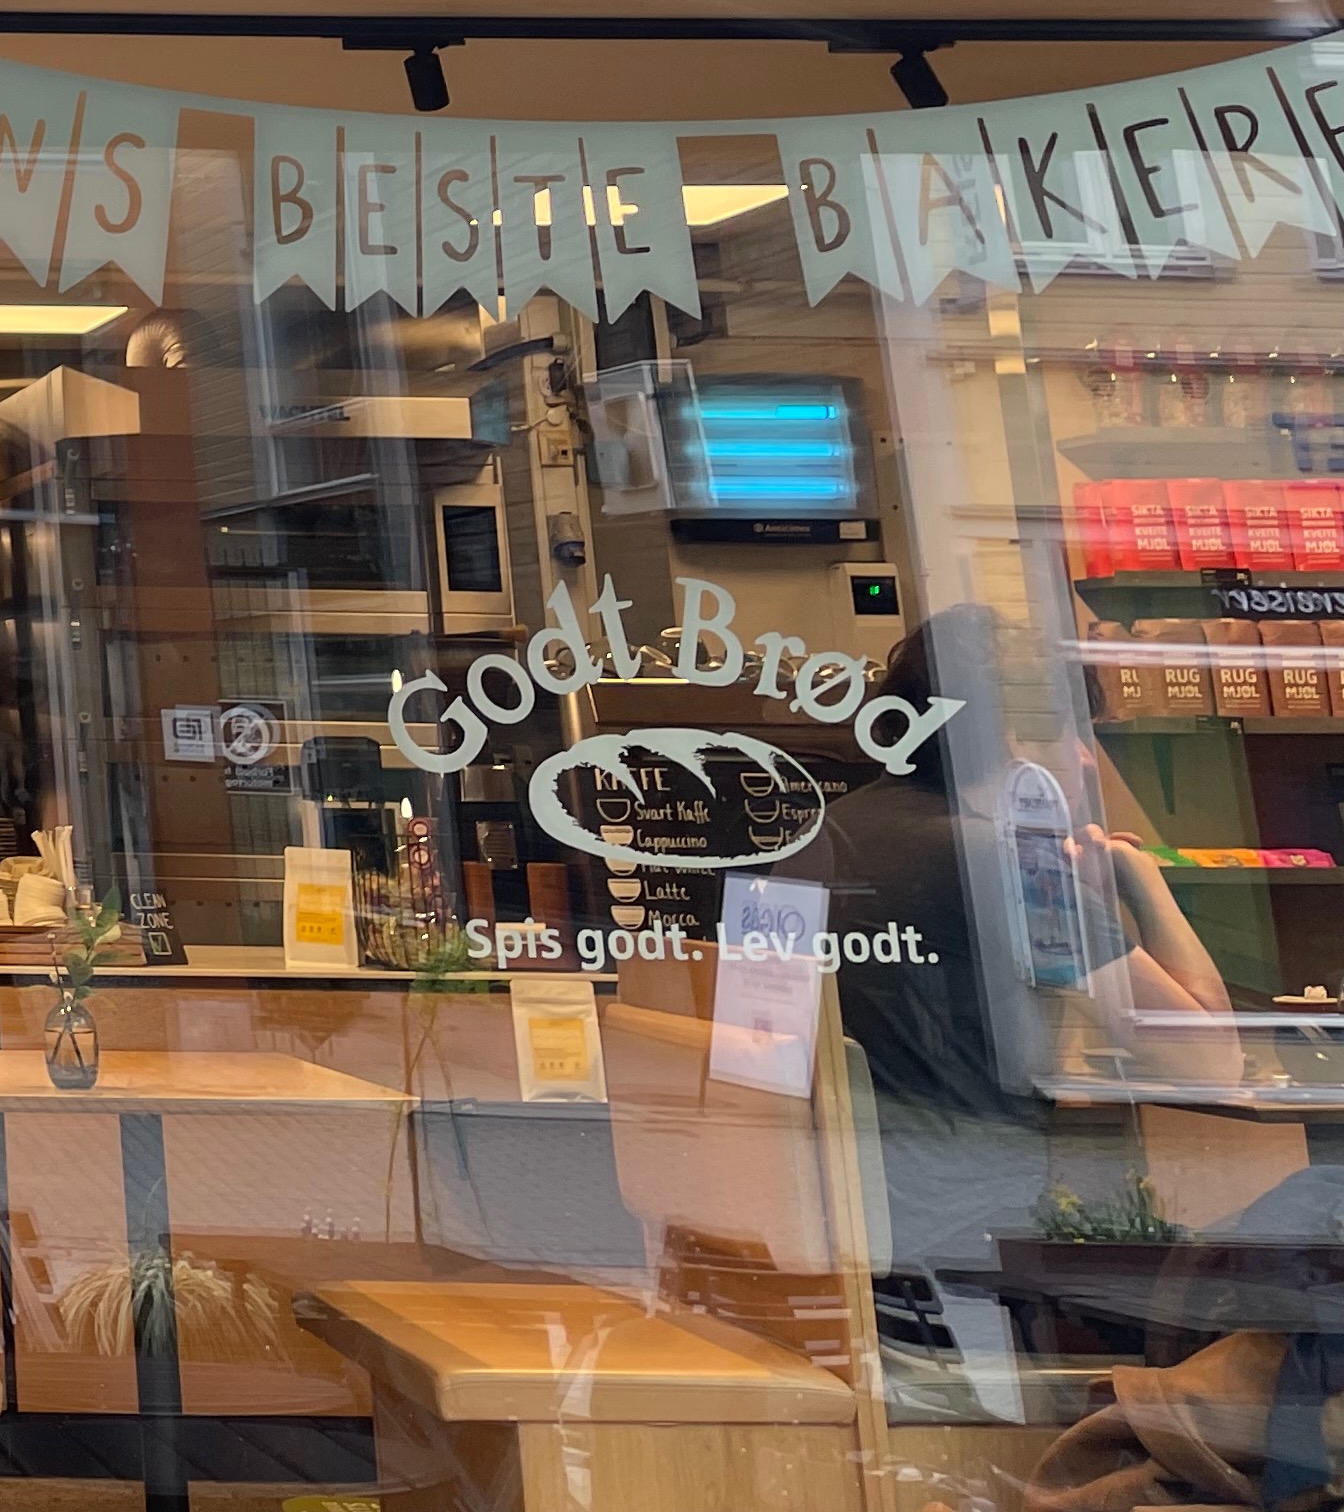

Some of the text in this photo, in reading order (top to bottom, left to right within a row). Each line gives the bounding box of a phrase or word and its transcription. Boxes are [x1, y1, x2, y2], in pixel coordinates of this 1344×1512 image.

[271, 153, 652, 263] BESTE
[386, 573, 968, 777] Godt Brød
[1165, 668, 1200, 683] RUG
[1220, 668, 1257, 684] RUG
[1283, 669, 1318, 684] RUG
[634, 800, 711, 824] Svart Kaffe
[636, 829, 708, 854] Cappuccino
[643, 880, 691, 900] Latte
[136, 912, 174, 929] ZONE
[465, 918, 563, 969] Spis
[576, 921, 703, 971] godt.
[717, 921, 796, 962] Lev
[812, 922, 940, 973] godt.
